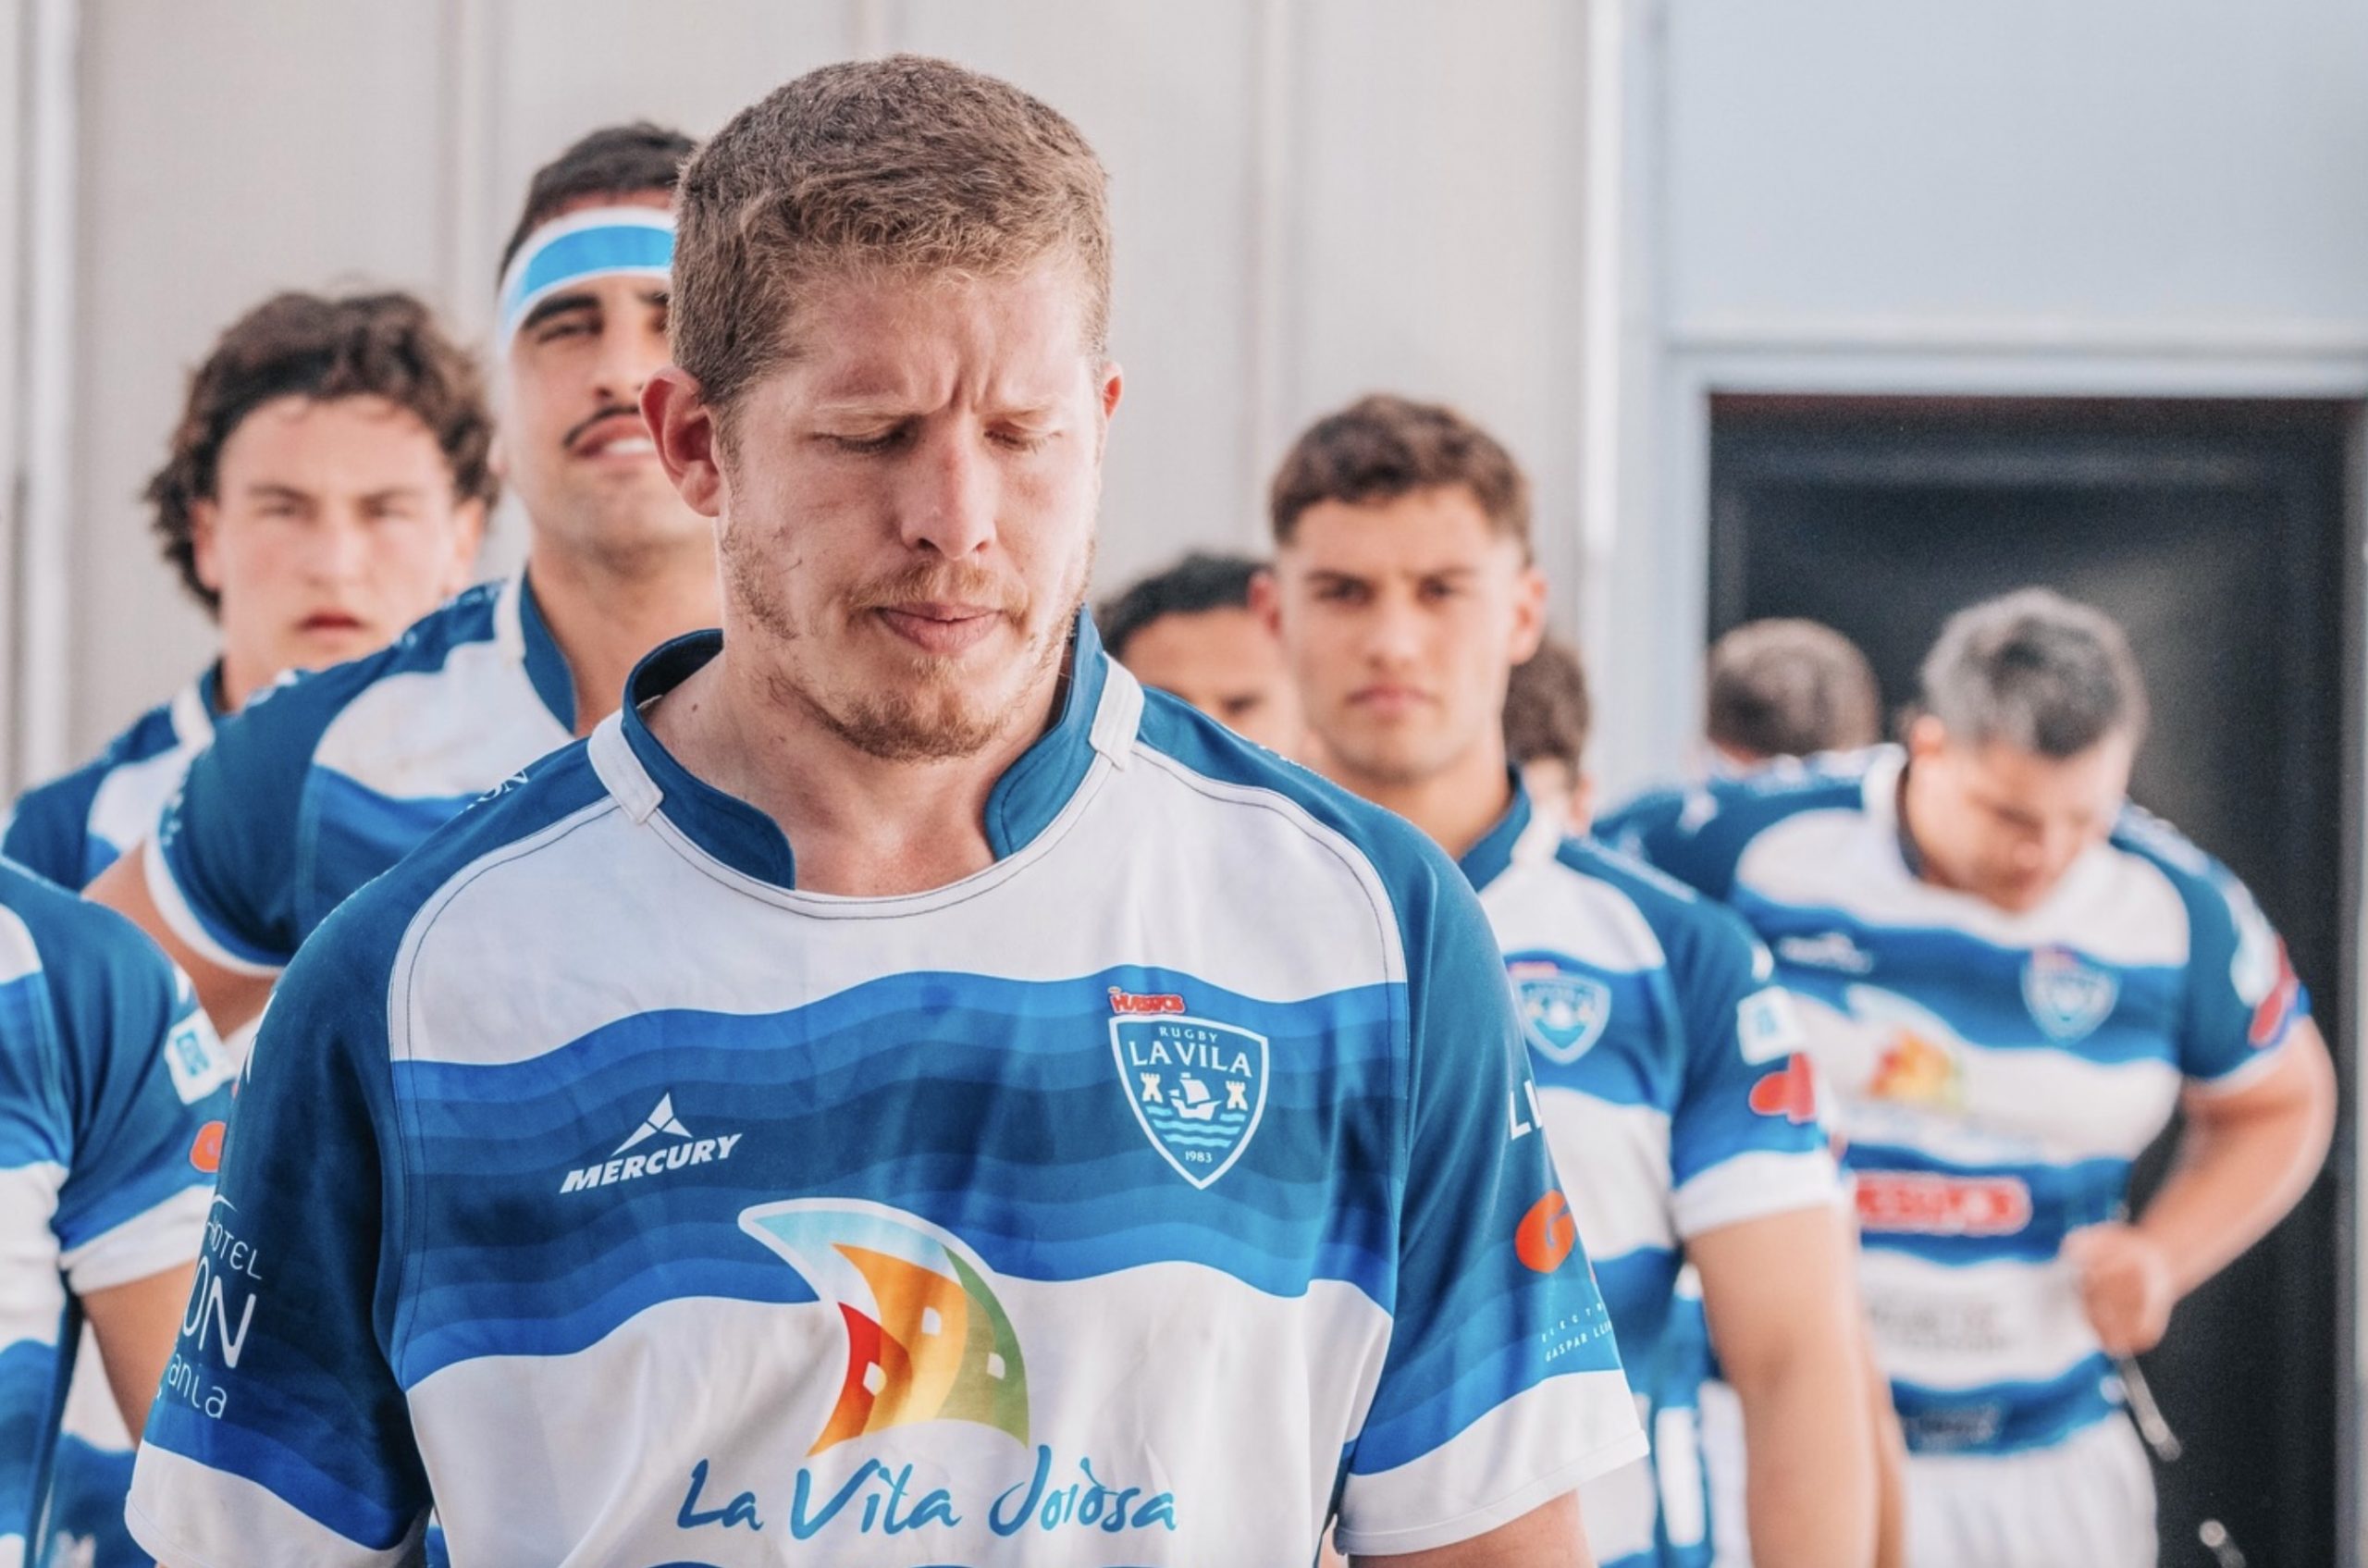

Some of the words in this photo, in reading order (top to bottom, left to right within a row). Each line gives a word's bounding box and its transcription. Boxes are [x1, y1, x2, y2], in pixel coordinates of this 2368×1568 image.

[1159, 1027, 1218, 1043] RUGBY
[559, 1133, 744, 1193] MERCURY
[1185, 1150, 1213, 1164] 1983
[676, 1458, 765, 1532] La
